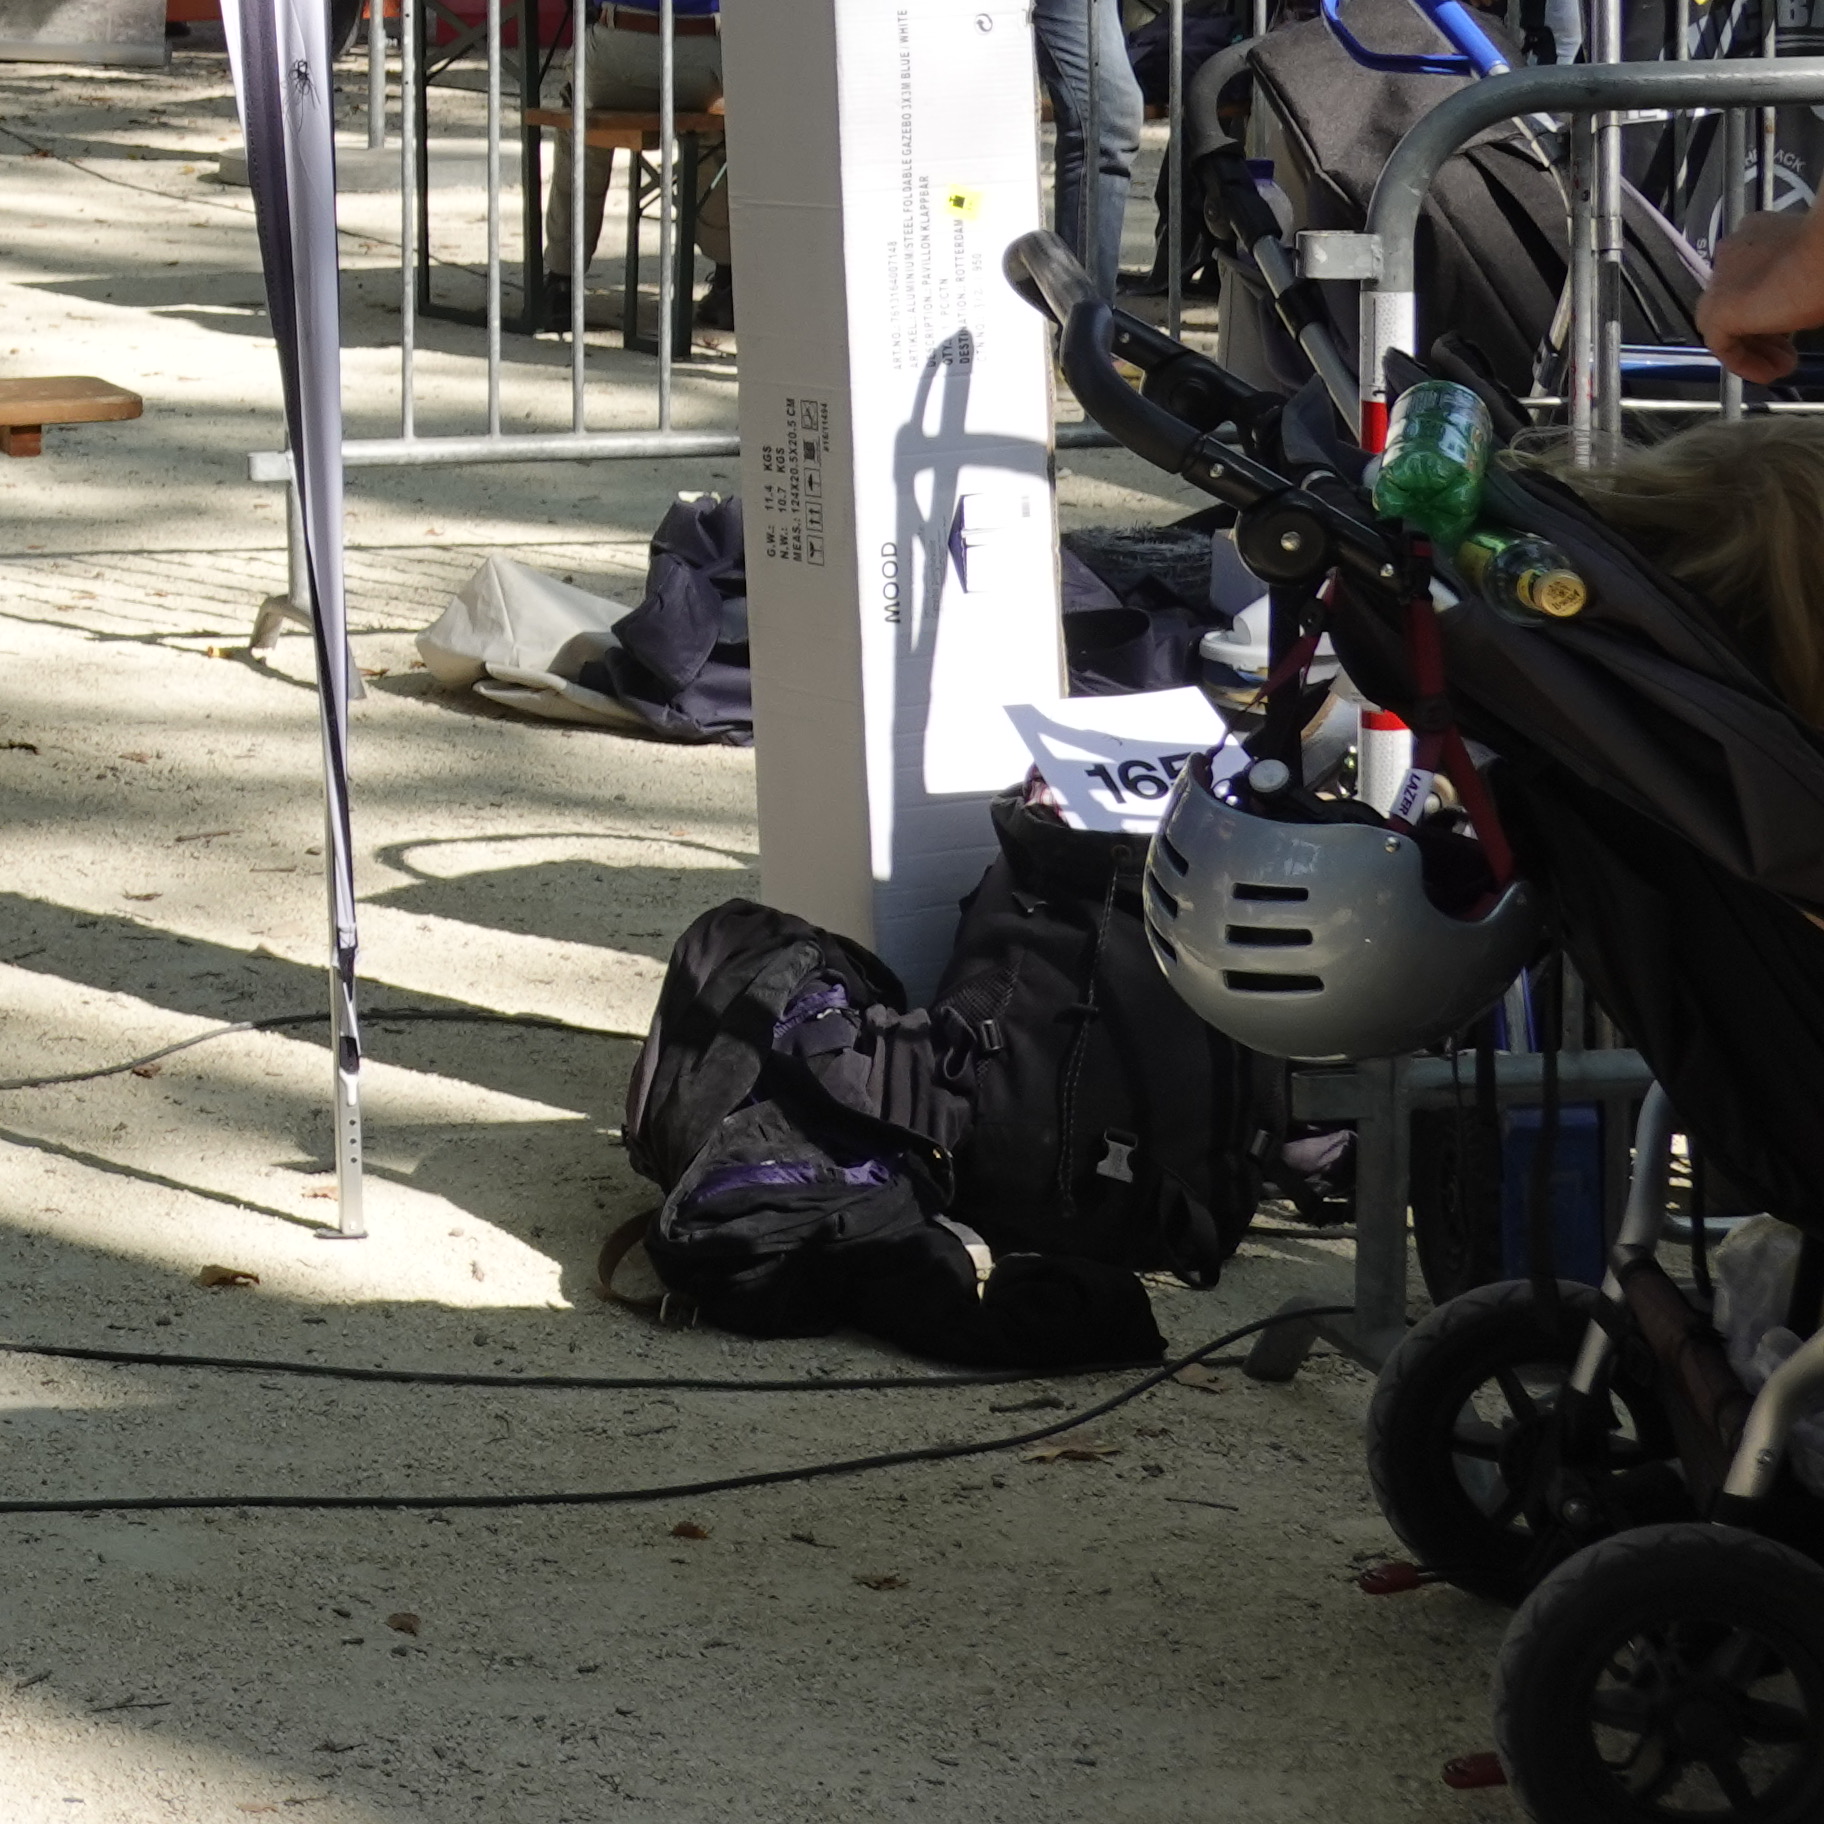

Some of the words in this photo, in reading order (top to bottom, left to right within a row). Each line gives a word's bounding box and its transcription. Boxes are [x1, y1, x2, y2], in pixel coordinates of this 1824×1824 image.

[897, 9, 909, 44] WHITE
[899, 51, 911, 80] BLUE
[901, 112, 913, 156] GAZEBO
[918, 174, 930, 232] KLAPPBAR
[919, 234, 932, 286] PAVILLON
[954, 218, 965, 283] ROTTERDAM
[786, 397, 796, 417] CM
[762, 445, 773, 472] KGS
[775, 447, 786, 474] KGS
[764, 484, 774, 511] 11.4
[777, 486, 787, 513] 10.7
[880, 541, 901, 624] MOOD
[1398, 773, 1421, 816] LAZER
